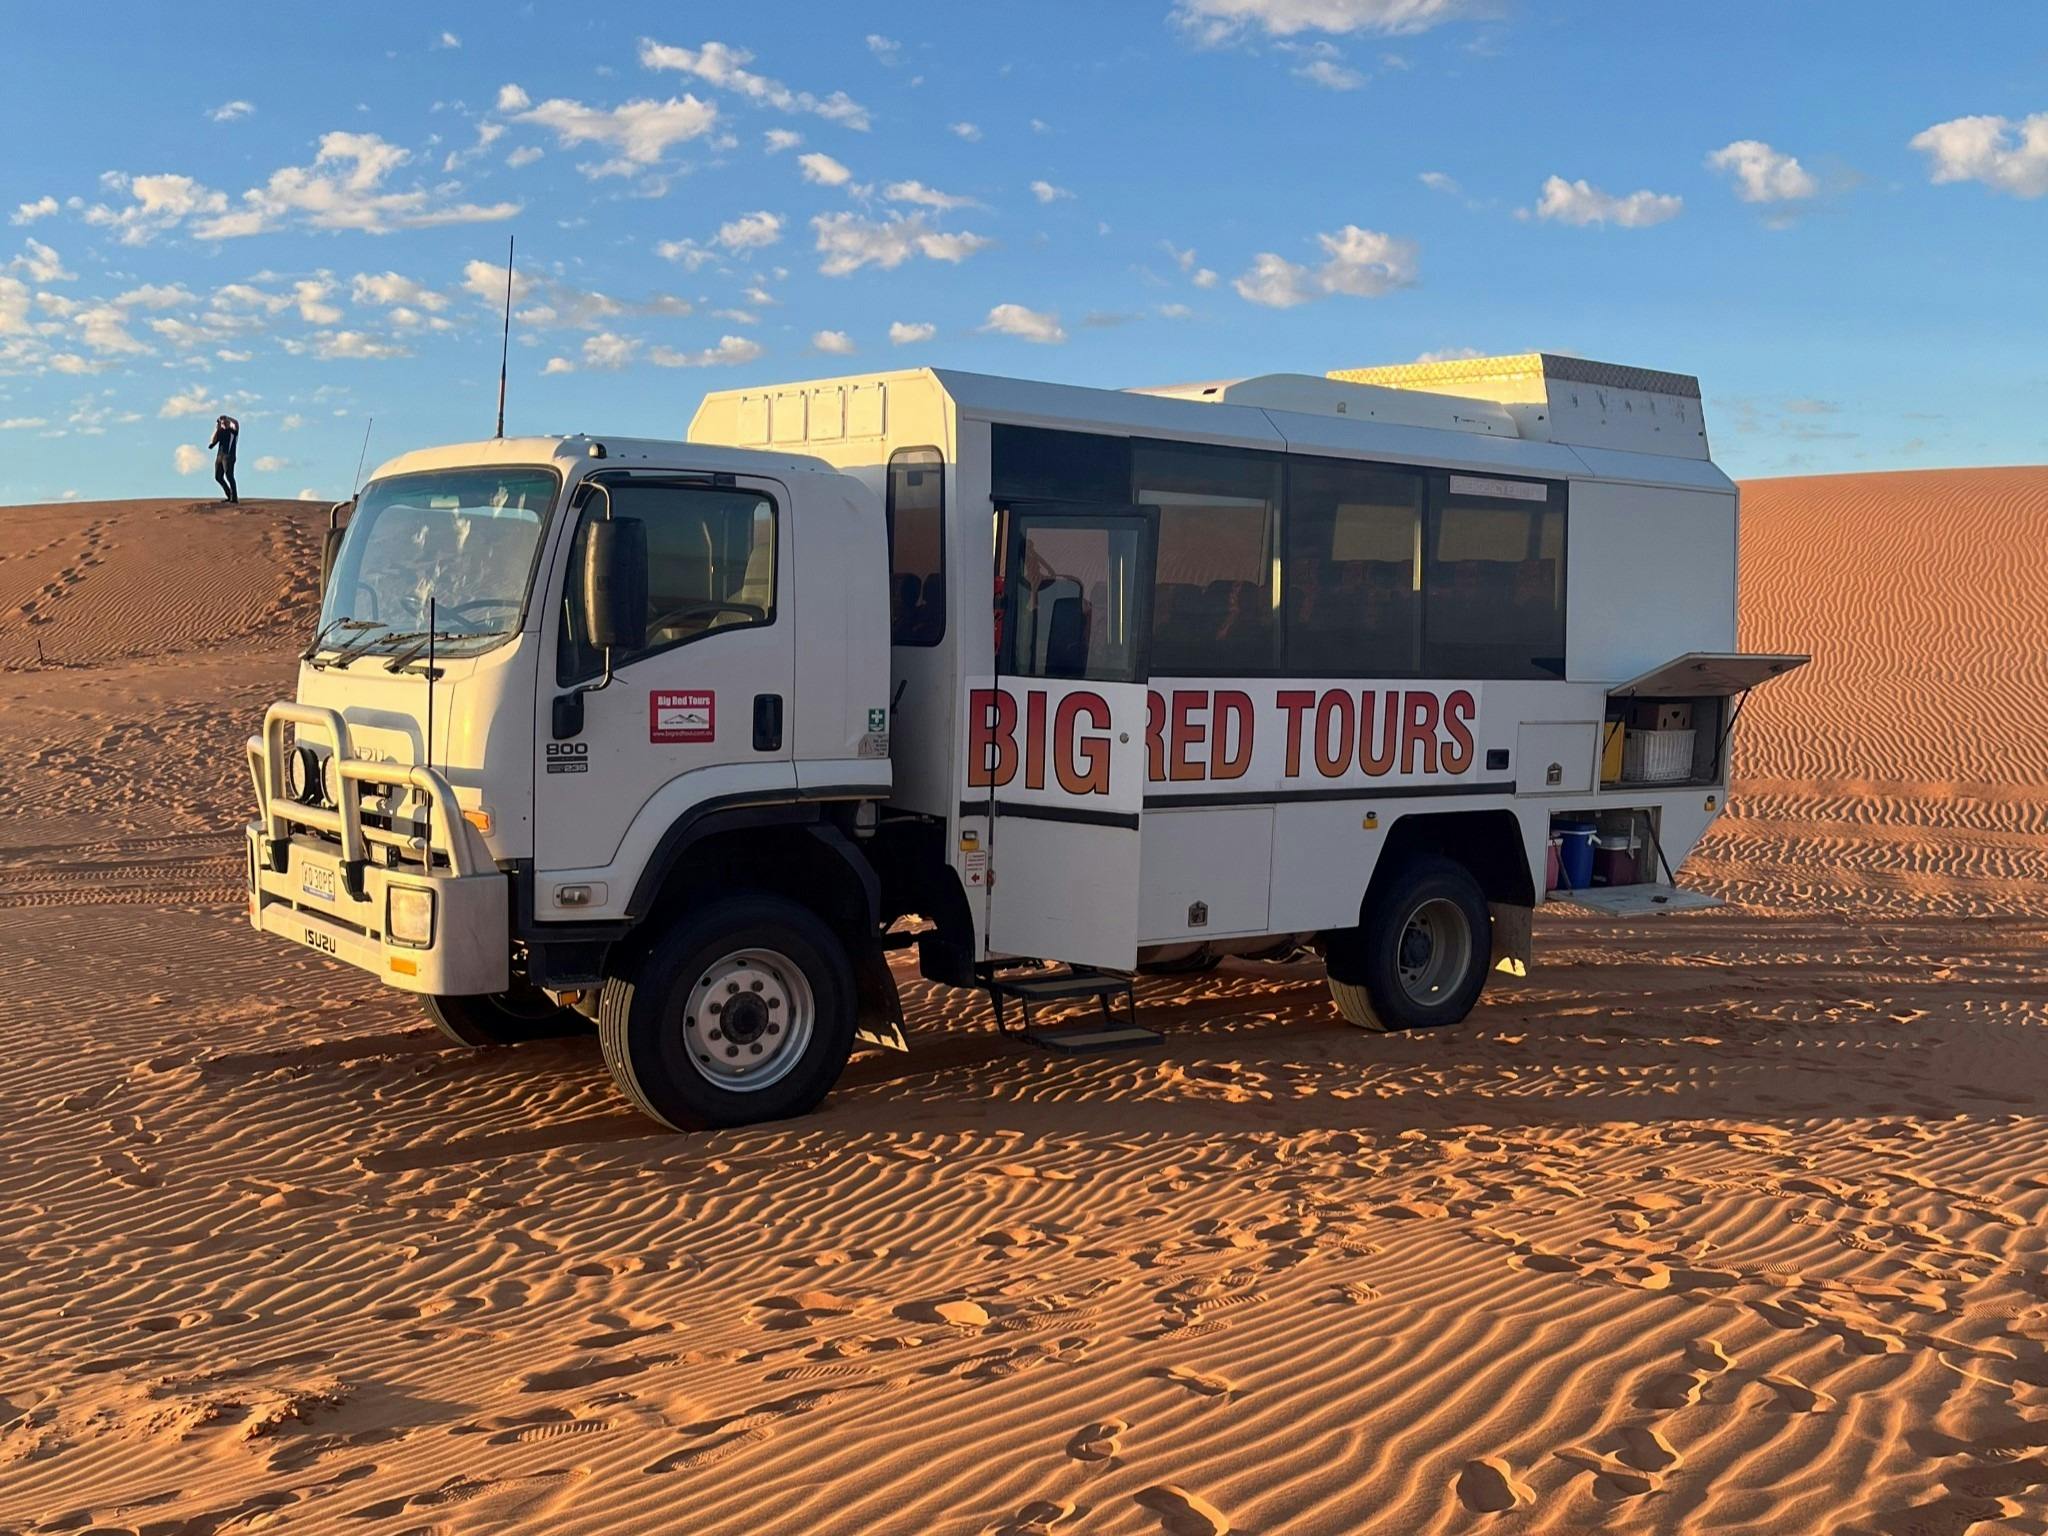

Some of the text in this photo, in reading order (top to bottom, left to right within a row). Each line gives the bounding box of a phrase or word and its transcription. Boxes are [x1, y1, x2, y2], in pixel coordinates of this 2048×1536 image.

[657, 695, 711, 707] Big Red Tours
[546, 742, 588, 755] 800
[967, 689, 1112, 796] BIG
[1276, 688, 1476, 779] TOURS
[304, 928, 336, 954] ISUZU
